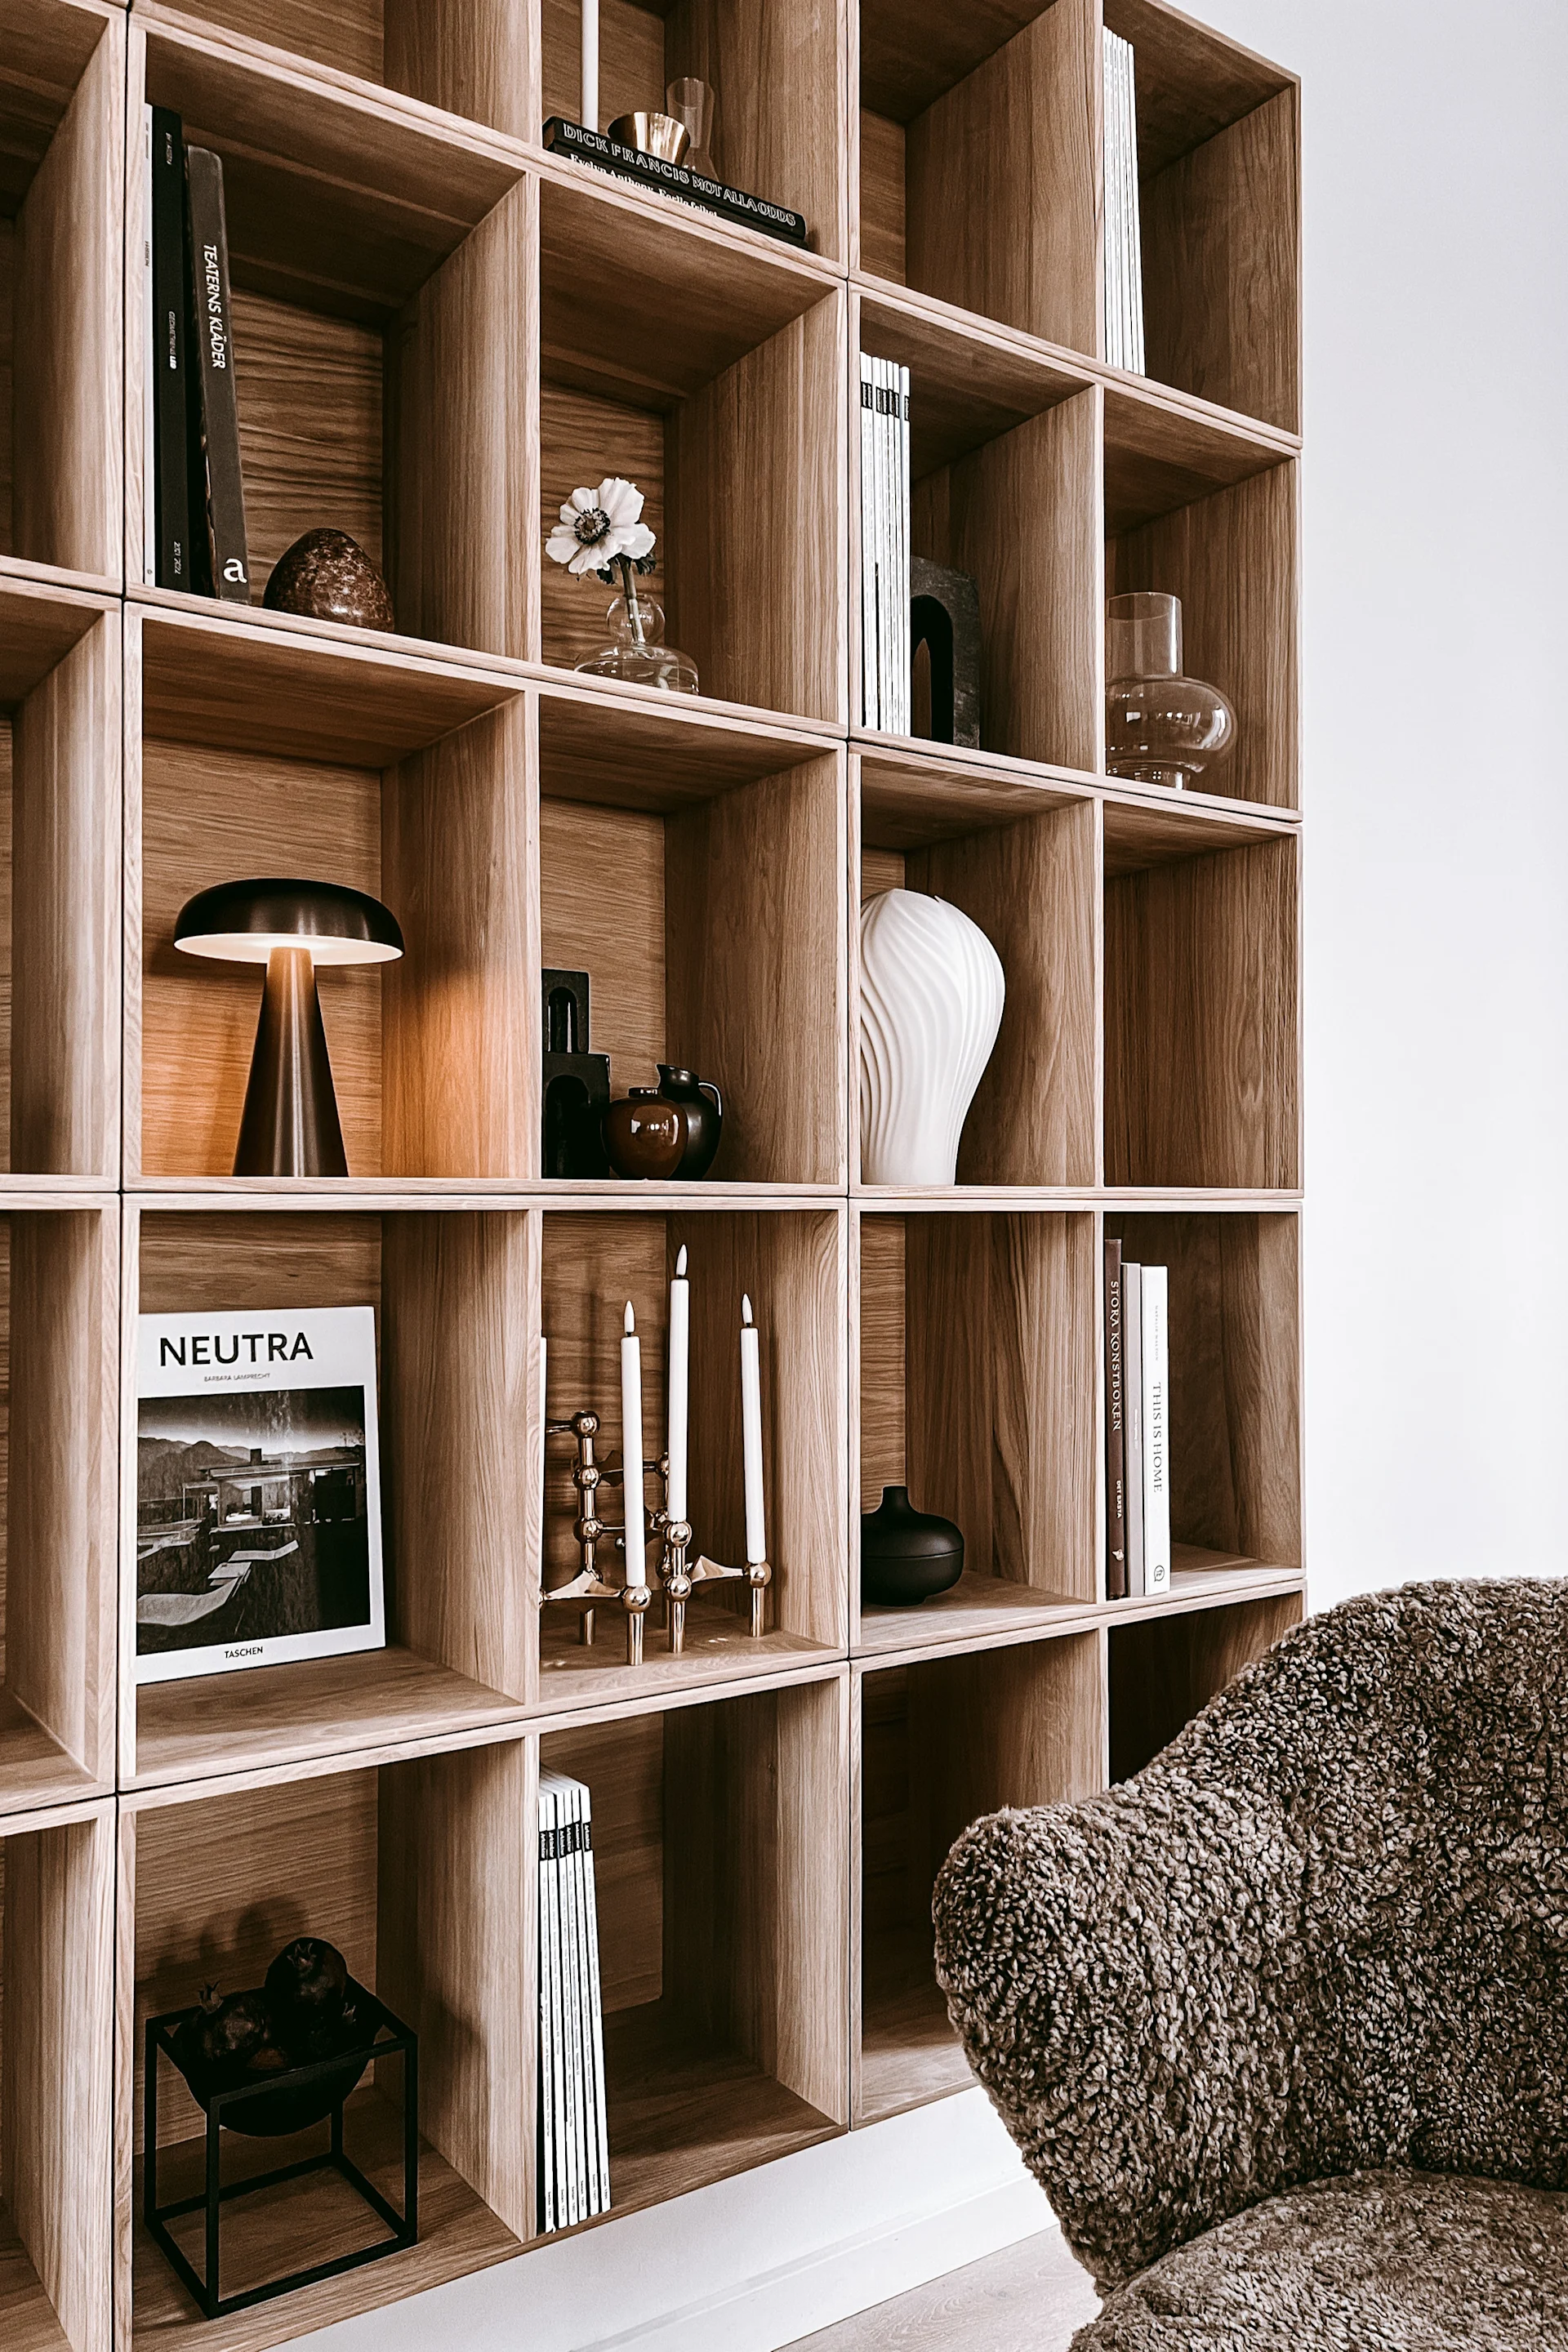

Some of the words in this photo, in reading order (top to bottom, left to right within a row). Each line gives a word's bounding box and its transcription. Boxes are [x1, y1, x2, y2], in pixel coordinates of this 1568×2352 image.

[564, 123, 608, 154] DICK
[611, 142, 690, 185] FRANCIS
[692, 175, 723, 198] MOT
[724, 189, 758, 212] ALLA
[758, 202, 796, 227] ODDS
[203, 244, 222, 314] TEATERNS
[208, 314, 226, 368] KLÄDER
[223, 558, 248, 584] a
[1109, 1281, 1120, 1327] STORA
[159, 1332, 314, 1366] NEUTRA
[233, 1373, 271, 1381] LAMPRECHT
[1110, 1332, 1121, 1432] KONSTBOKEN
[1153, 1381, 1161, 1420] THIS
[1153, 1425, 1161, 1438] IS
[1153, 1444, 1162, 1493] HOME
[225, 1646, 263, 1659] TASCHEN
